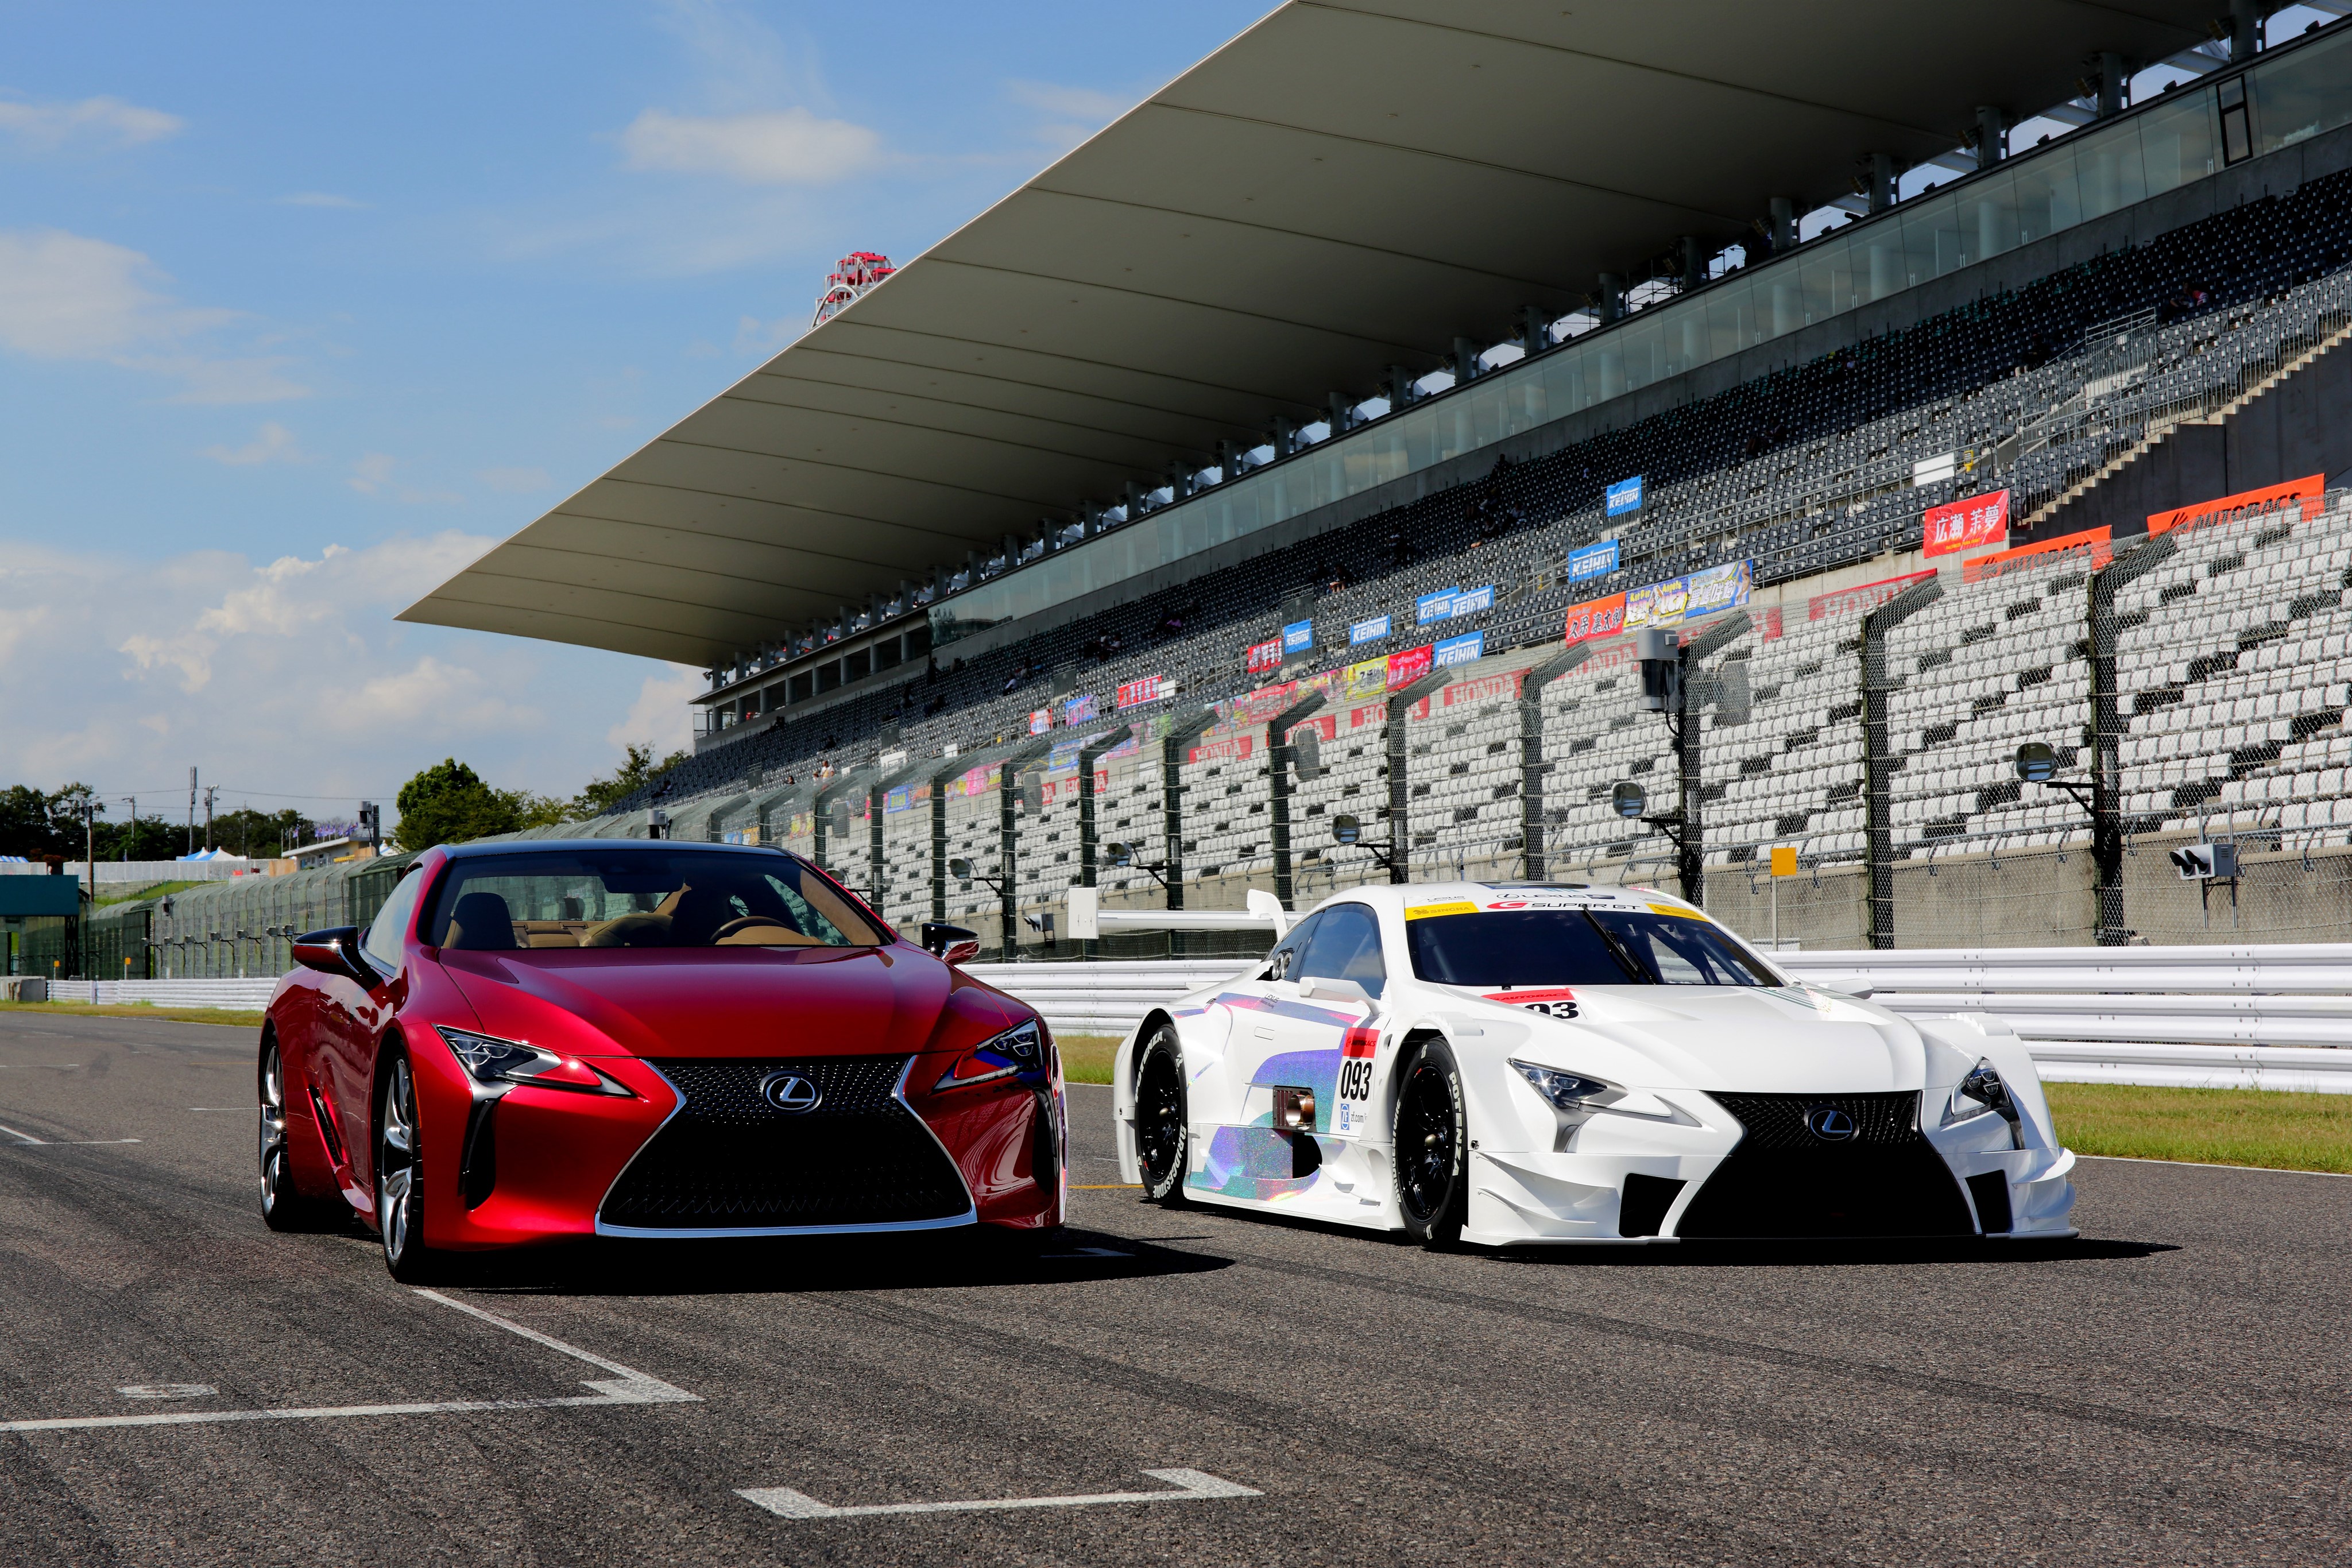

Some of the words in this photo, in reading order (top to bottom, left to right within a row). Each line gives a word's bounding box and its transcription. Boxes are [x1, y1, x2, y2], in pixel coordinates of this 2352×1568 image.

[1609, 490, 1639, 509] KEIHIN
[1572, 550, 1615, 576] KEIHIN
[1451, 593, 1490, 617] KEIHIN
[1286, 632, 1310, 647] KEIHIN
[1352, 620, 1387, 642] KEIHIN
[1436, 644, 1479, 667] KEIHIN
[1452, 673, 1516, 704] HONDA
[1195, 738, 1242, 761] HONDA
[1500, 993, 1569, 1001] AUTOBACS
[1351, 1039, 1376, 1047] AUTOBACS
[1135, 1031, 1163, 1104] POTENZA
[1341, 1060, 1372, 1101] 093
[1448, 1071, 1463, 1176] POTENZA
[1153, 1122, 1187, 1199] BRIDGESTONE
